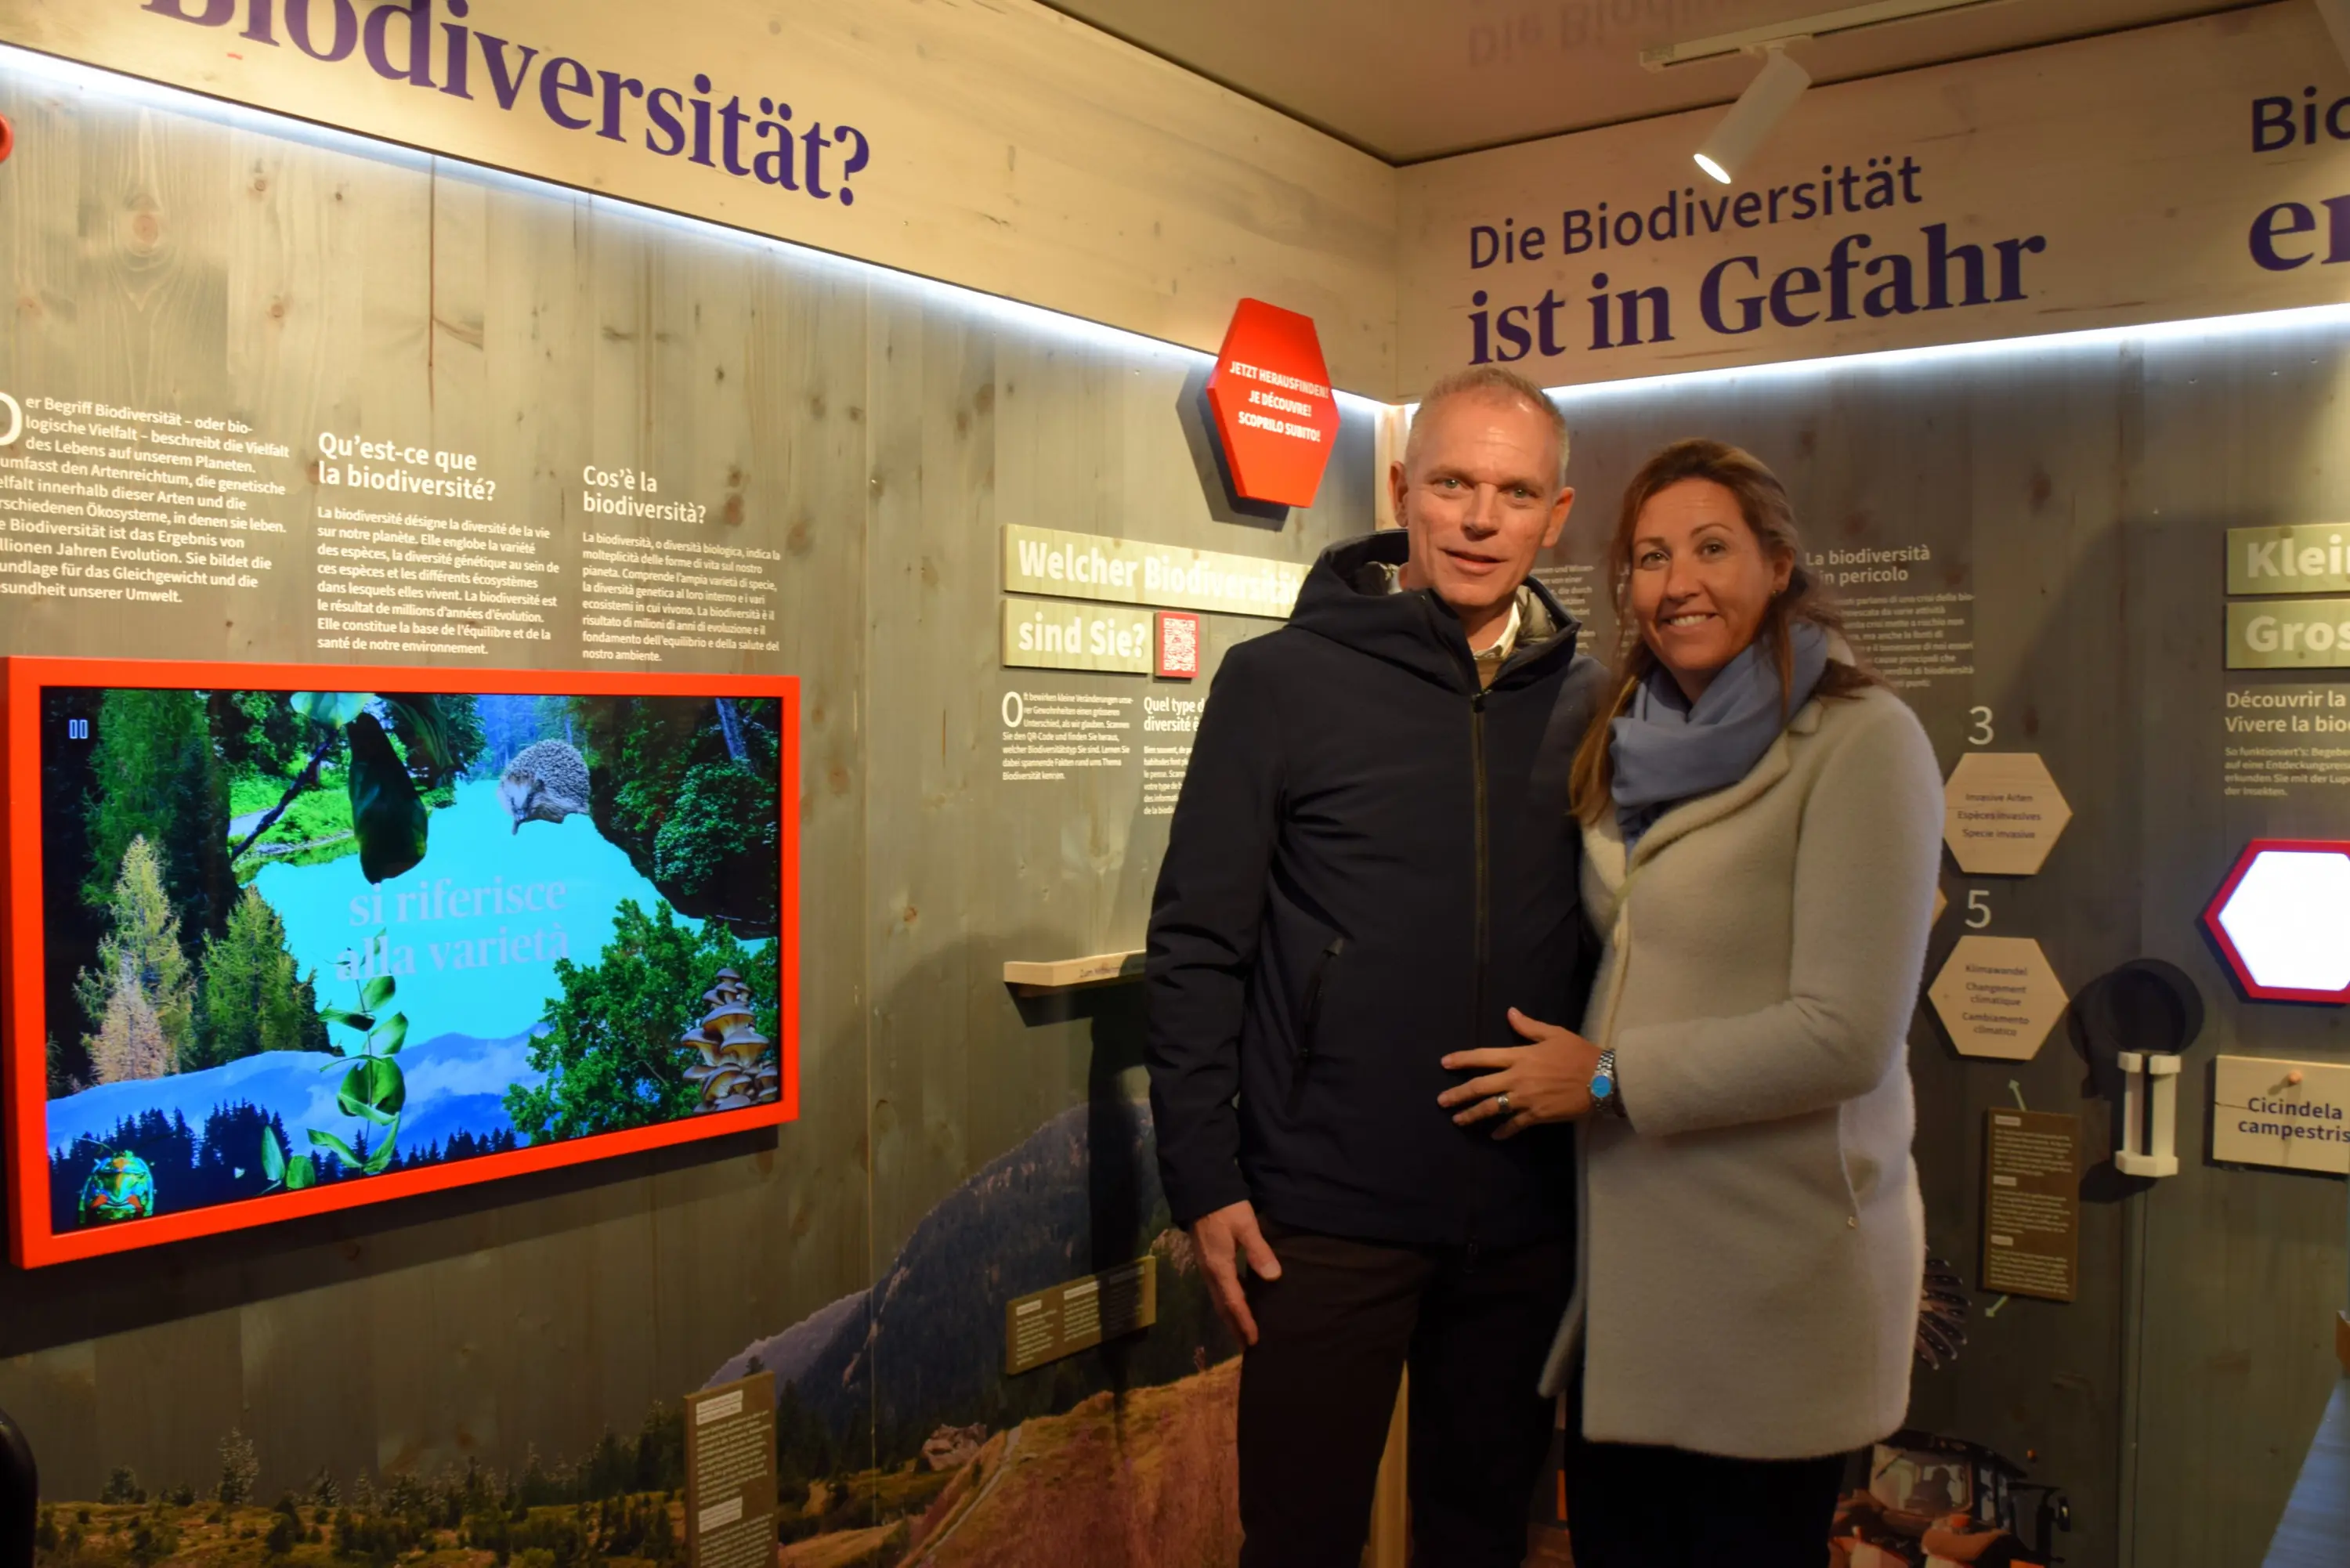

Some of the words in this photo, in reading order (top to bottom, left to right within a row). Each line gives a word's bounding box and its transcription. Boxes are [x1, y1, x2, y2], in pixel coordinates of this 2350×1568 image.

[1470, 219, 1546, 269] Die
[1563, 156, 1922, 256] Biodiversität
[1469, 285, 1566, 367] ist
[1587, 272, 1676, 351] in
[1699, 222, 2047, 335] Gefahr
[1229, 360, 1259, 380] JETZT
[1259, 369, 1329, 399] HERAUSFINDEN!
[44, 397, 92, 416] Begriff
[95, 403, 182, 426] Biodiversität
[194, 417, 226, 431] oder
[227, 419, 252, 433] bio-
[1248, 390, 1261, 403] JE
[1261, 392, 1312, 417] DÉCOUVRE!
[26, 414, 86, 434] logische
[88, 423, 137, 441] Vielfalt
[150, 429, 221, 450] beschreibt
[223, 439, 244, 452] die
[244, 442, 289, 457] Vielfalt
[1238, 411, 1284, 433] SCOPRILO
[1285, 421, 1321, 443] SUBITO!
[26, 436, 52, 451] des
[55, 439, 106, 457] Lebens
[108, 446, 132, 459] auf
[133, 451, 193, 466] unserem
[195, 455, 255, 472] Planeten.
[319, 432, 428, 464] Qu’est-ce
[435, 451, 476, 473] que
[0, 456, 58, 472] umfasst
[60, 461, 88, 475] den
[90, 464, 193, 488] Artenreichtum,
[195, 474, 216, 488] die
[218, 479, 285, 494] genetische
[319, 461, 340, 485] la
[348, 464, 495, 500] biodiversité?
[584, 465, 634, 490] Cos’è
[641, 471, 656, 492] la
[38, 479, 108, 497] innerhalb
[111, 486, 155, 501] dieser
[157, 490, 194, 505] Arten
[197, 496, 222, 508] und
[226, 497, 246, 510] die
[584, 491, 706, 523] biodiversità?
[9, 518, 107, 537] Biodiversität
[109, 526, 126, 539] ist
[129, 527, 155, 541] das
[157, 530, 217, 547] Ergebnis
[219, 537, 244, 547] von
[86, 501, 171, 526] Ökosysteme,
[173, 511, 186, 524] in
[188, 512, 228, 527] denen
[230, 517, 248, 529] sie
[249, 518, 286, 533] leben.
[317, 506, 332, 518] La
[334, 507, 403, 525] biodiversité
[404, 514, 447, 530] désigne
[449, 518, 459, 529] la
[461, 519, 507, 534] diversité
[508, 524, 522, 536] de
[523, 526, 533, 537] la
[534, 527, 550, 538] vie
[56, 543, 107, 558] Jahren
[110, 546, 182, 563] Evolution.
[185, 551, 207, 565] Sie
[209, 553, 248, 568] bildet
[251, 556, 272, 569] die
[317, 527, 337, 537] sur
[338, 528, 371, 540] notre
[372, 529, 418, 544] planète.
[421, 533, 442, 546] Elle
[443, 537, 486, 551] englobe
[488, 539, 498, 551] la
[500, 542, 535, 554] variété
[584, 532, 595, 542] La
[596, 533, 654, 550] biodiversità,
[663, 539, 701, 552] diversità
[703, 543, 745, 558] biologica,
[746, 547, 772, 559] indica
[772, 550, 780, 560] la
[1806, 552, 1824, 566] La
[1829, 544, 1930, 565] biodiversità
[2247, 533, 2350, 578] Klei
[60, 562, 82, 576] für
[85, 565, 110, 578] das
[112, 566, 208, 585] Gleichgewicht
[210, 573, 235, 586] und
[237, 574, 258, 587] die
[1018, 540, 1137, 587] Welcher
[1839, 566, 1908, 587] pericolo
[69, 587, 123, 599] unserer
[125, 587, 182, 602] Umwelt.
[1018, 611, 1081, 655] sind
[1090, 616, 1144, 659] Sie?
[1144, 696, 1170, 714] Quel
[1172, 697, 1195, 716] type
[2226, 691, 2323, 708] Découvrir
[2328, 690, 2346, 708] la
[1144, 715, 1191, 732] diversité
[1967, 705, 1994, 746] 3
[2225, 716, 2287, 732] Vivere
[2292, 715, 2312, 732] la
[2315, 714, 2350, 732] bio
[2225, 747, 2238, 756] So
[2225, 761, 2240, 769] auf
[2242, 761, 2264, 770] eine
[2224, 774, 2271, 782] erkunden
[2273, 773, 2289, 782] Sie
[2290, 773, 2308, 782] mit
[2310, 774, 2327, 782] der
[2330, 775, 2350, 785] Lup
[2224, 787, 2240, 796] der
[2243, 787, 2288, 797] Insekten.
[349, 882, 385, 927] si
[396, 876, 569, 923] riferisce
[1965, 889, 1992, 929] 5
[335, 935, 417, 981] alla
[428, 922, 570, 972] varietà
[2248, 1097, 2343, 1120] Cicindela
[2238, 1120, 2350, 1143] campestris
